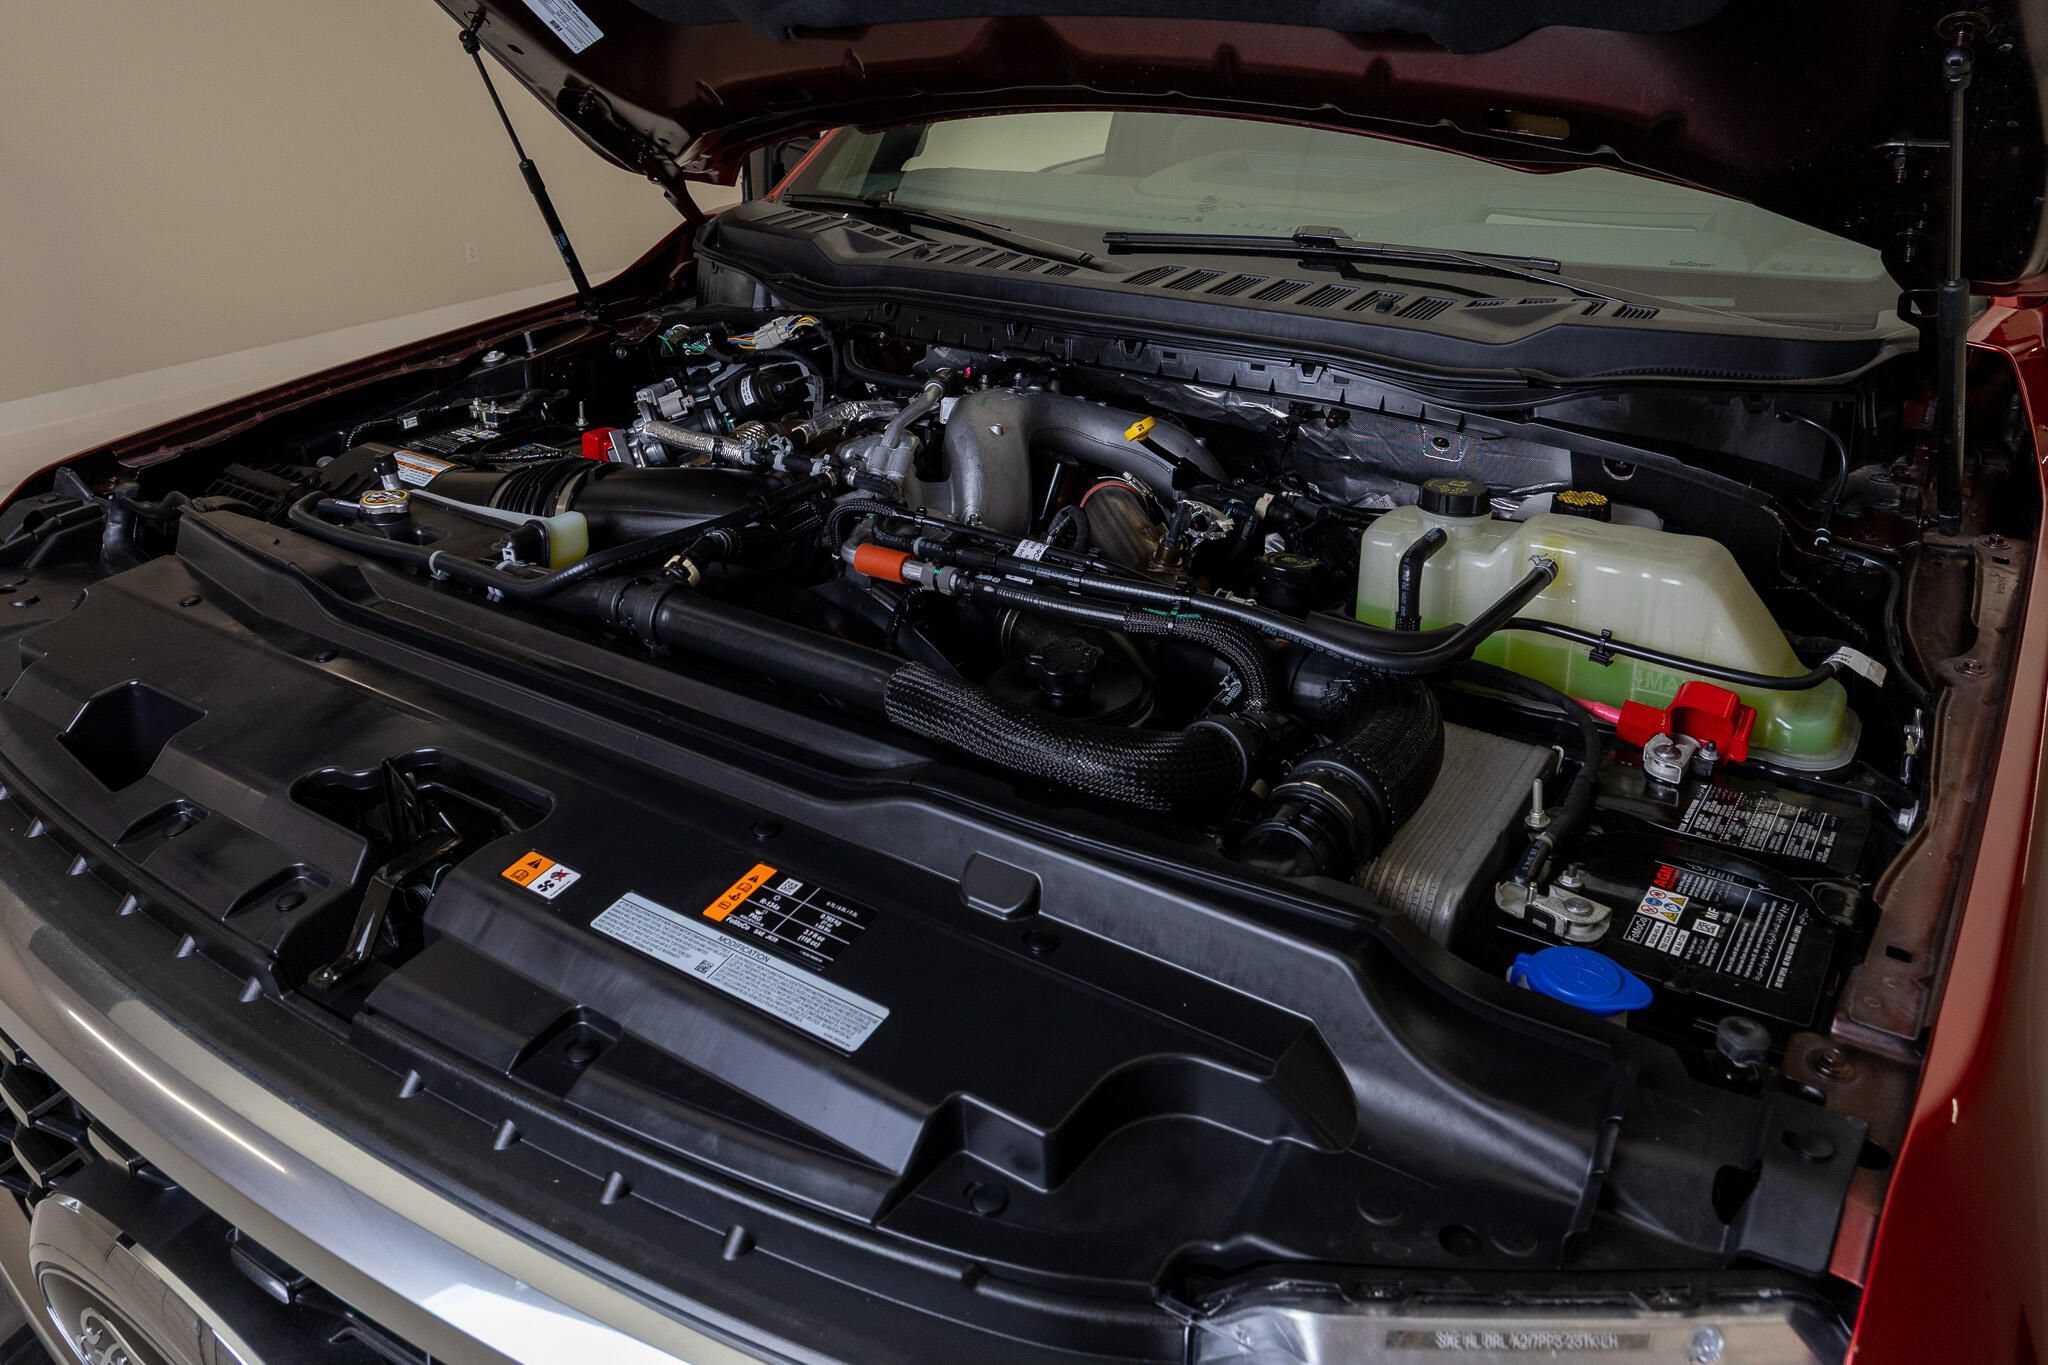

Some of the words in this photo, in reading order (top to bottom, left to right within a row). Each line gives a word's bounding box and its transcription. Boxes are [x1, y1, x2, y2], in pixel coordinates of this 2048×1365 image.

[1653, 864, 1674, 888] AGM
[749, 912, 763, 922] PAG
[1704, 907, 1720, 921] MF
[1628, 917, 1648, 942] FoMoCo
[718, 936, 770, 963] MODIFICATION
